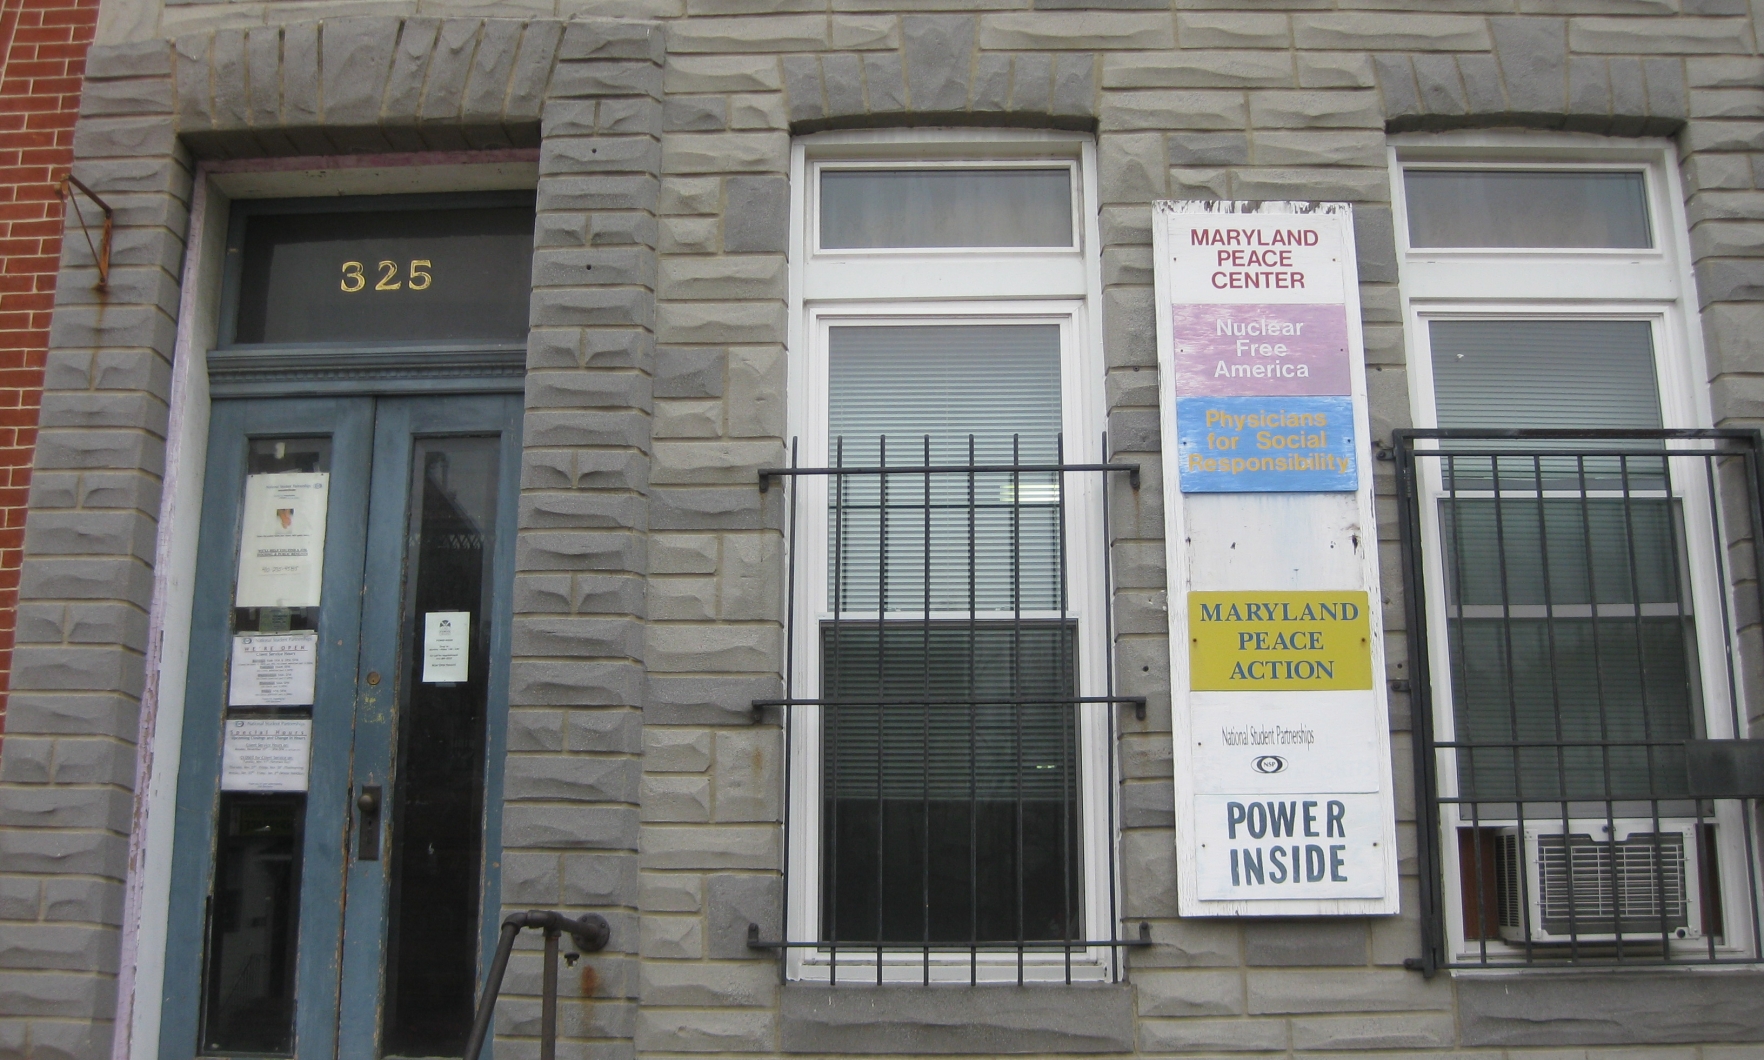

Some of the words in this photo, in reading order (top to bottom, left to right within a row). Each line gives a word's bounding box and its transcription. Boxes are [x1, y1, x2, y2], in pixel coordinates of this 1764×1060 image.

[1190, 229, 1319, 246] MARYLAND
[1217, 250, 1293, 267] PEACE
[340, 260, 432, 292] 325
[1211, 271, 1305, 289] CENTER
[1216, 318, 1304, 336] Nuclear
[1236, 339, 1288, 357] Free
[1214, 360, 1309, 378] America
[1206, 409, 1327, 431] Physicians
[1207, 432, 1239, 450] for
[1256, 431, 1327, 449] Social
[1188, 453, 1350, 475] Responsibility
[1199, 602, 1359, 622] MARYLAND
[1238, 631, 1325, 651] PEACE
[1229, 660, 1335, 680] ACTION
[1222, 724, 1249, 746] National
[1250, 724, 1275, 746] Student
[1276, 722, 1315, 751] Partnerships
[1227, 800, 1346, 839] POWER
[1230, 844, 1348, 886] INSIDE
